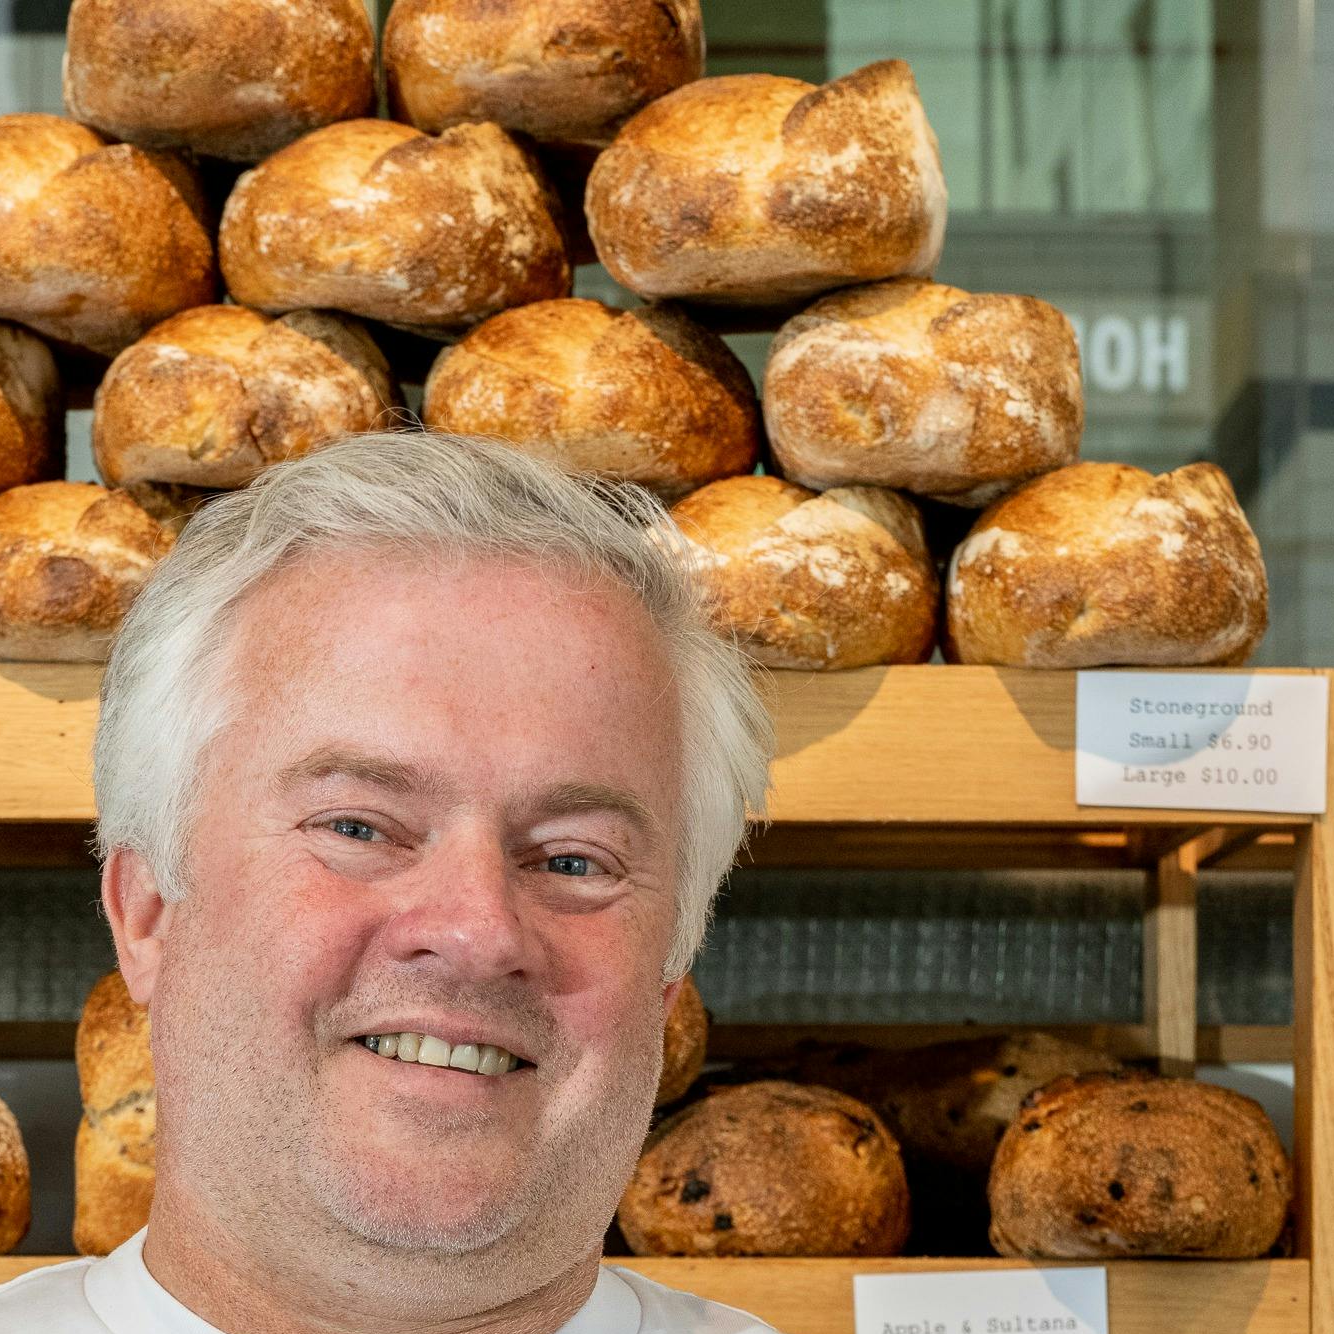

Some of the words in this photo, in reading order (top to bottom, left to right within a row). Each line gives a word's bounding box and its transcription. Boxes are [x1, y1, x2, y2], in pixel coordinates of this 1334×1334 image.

[1130, 698, 1273, 719] Stoneground
[1129, 733, 1193, 749] Small
[1207, 734, 1272, 751] $6.90
[1123, 767, 1187, 787] Large
[1201, 767, 1279, 786] $10.00
[961, 1320, 972, 1334] &
[986, 1315, 1078, 1334] Sultana
